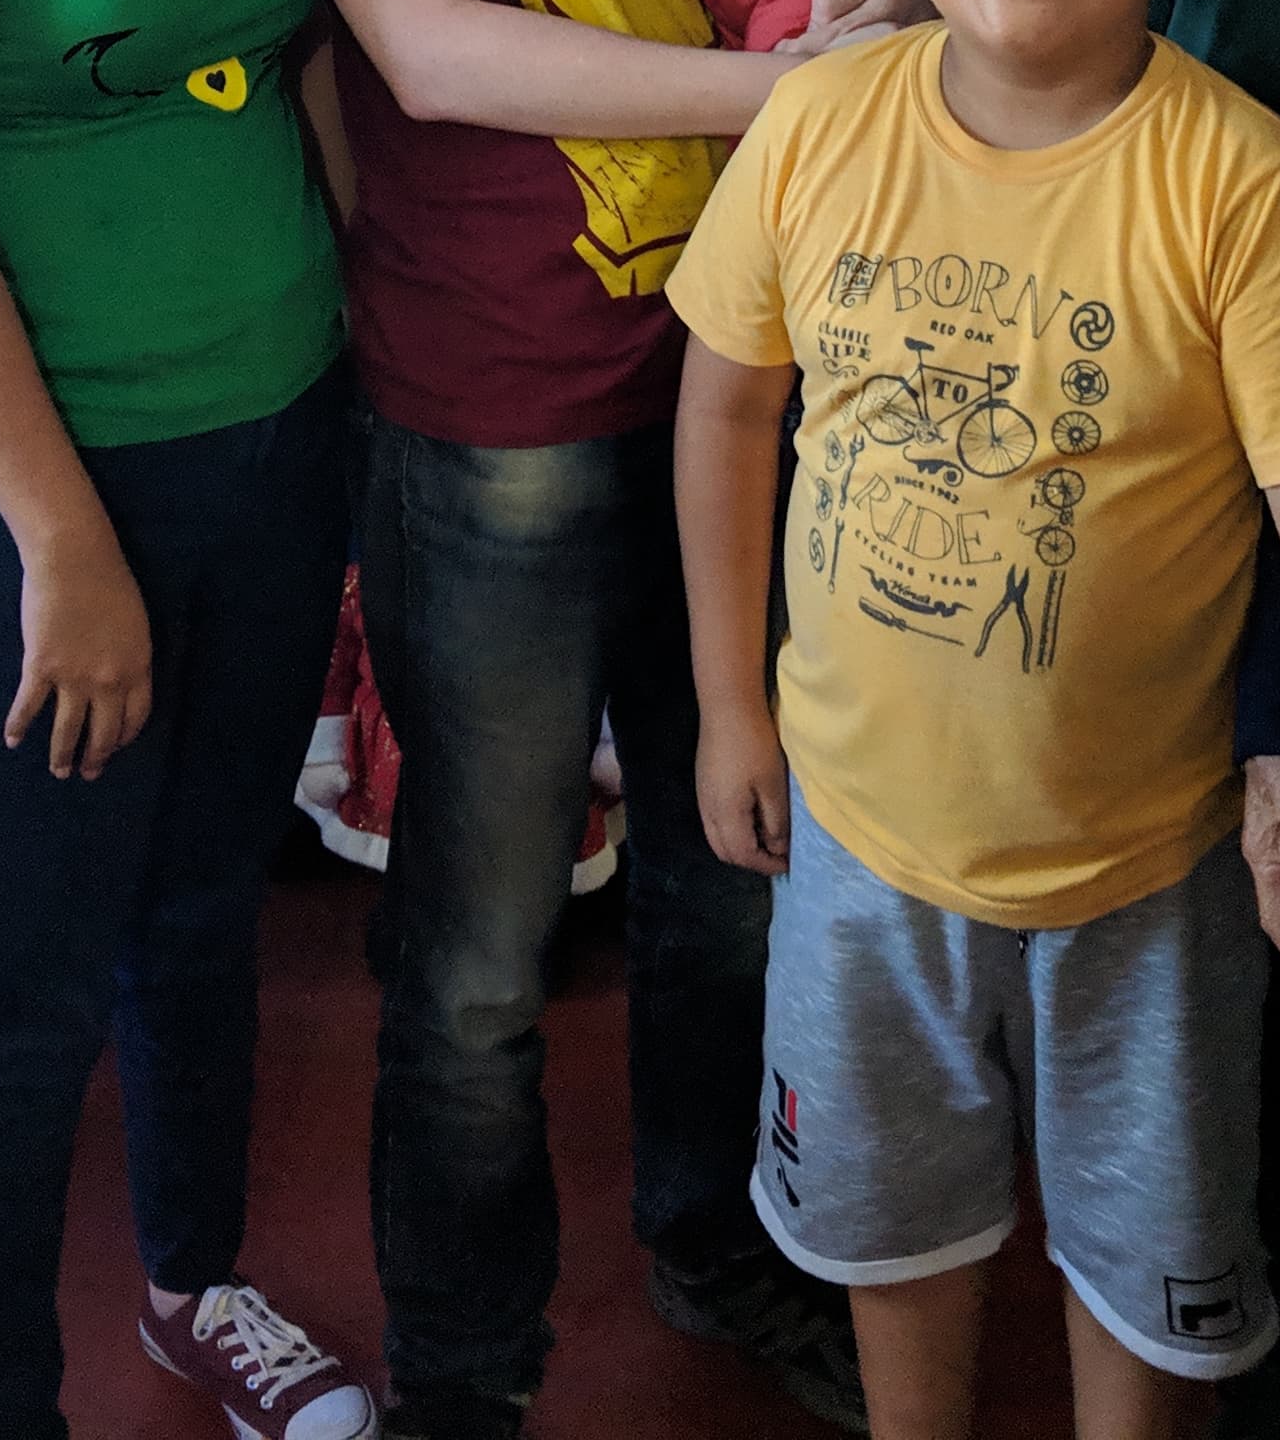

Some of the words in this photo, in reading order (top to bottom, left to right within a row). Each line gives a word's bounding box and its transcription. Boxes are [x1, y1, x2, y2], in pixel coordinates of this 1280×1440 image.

[888, 253, 1074, 340] BORN
[817, 320, 871, 346] CLASSIC
[930, 320, 956, 337] RED
[964, 328, 995, 345] OAK
[932, 377, 969, 404] TO
[850, 472, 1002, 565] RIDE
[854, 529, 915, 577] CYCLING
[928, 572, 977, 588] TEAM
